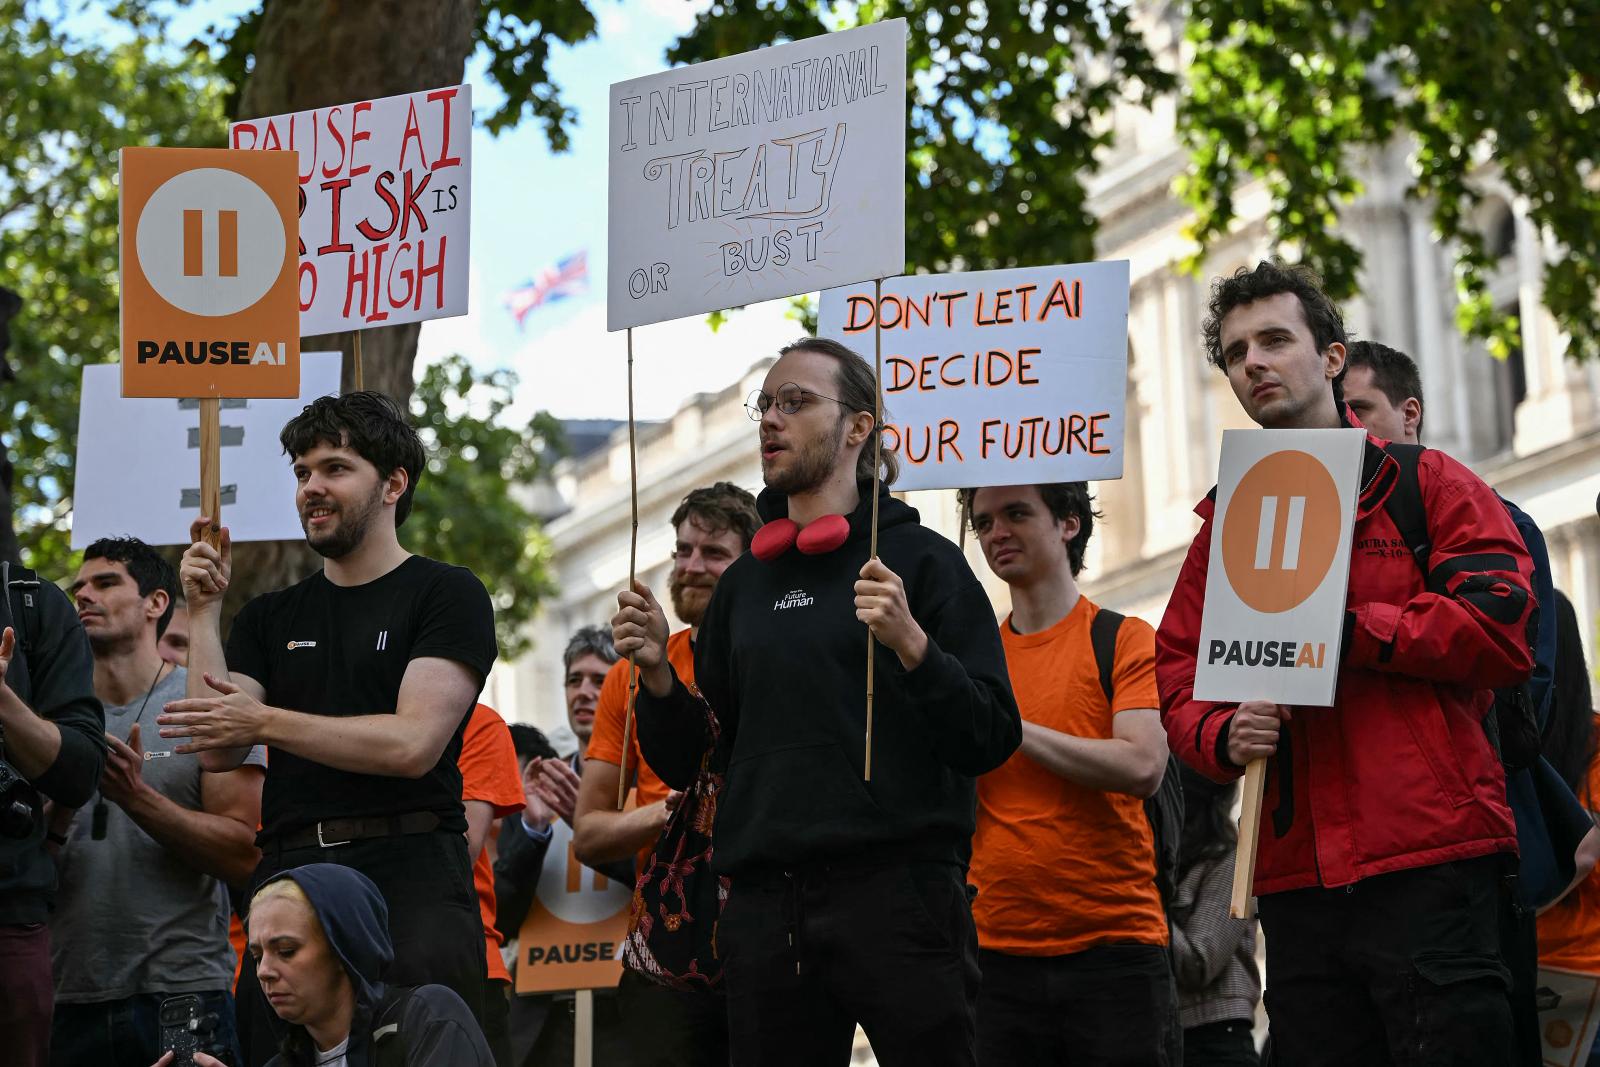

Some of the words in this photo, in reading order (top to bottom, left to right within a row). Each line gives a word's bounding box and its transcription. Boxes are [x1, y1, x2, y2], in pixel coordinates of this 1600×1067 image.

[399, 88, 463, 172] AI
[620, 45, 888, 153] INTERNATIONAL
[432, 184, 458, 213] IS
[643, 122, 847, 230] TREATY
[342, 235, 447, 324] HIGH
[628, 262, 670, 300] OR
[719, 221, 824, 277] BUST
[842, 290, 969, 334] DON'T
[975, 284, 1038, 327] LET
[1037, 278, 1084, 322] AI
[885, 348, 1042, 393] DECIDE
[979, 412, 1112, 460] FUTURE
[774, 597, 813, 610] Human
